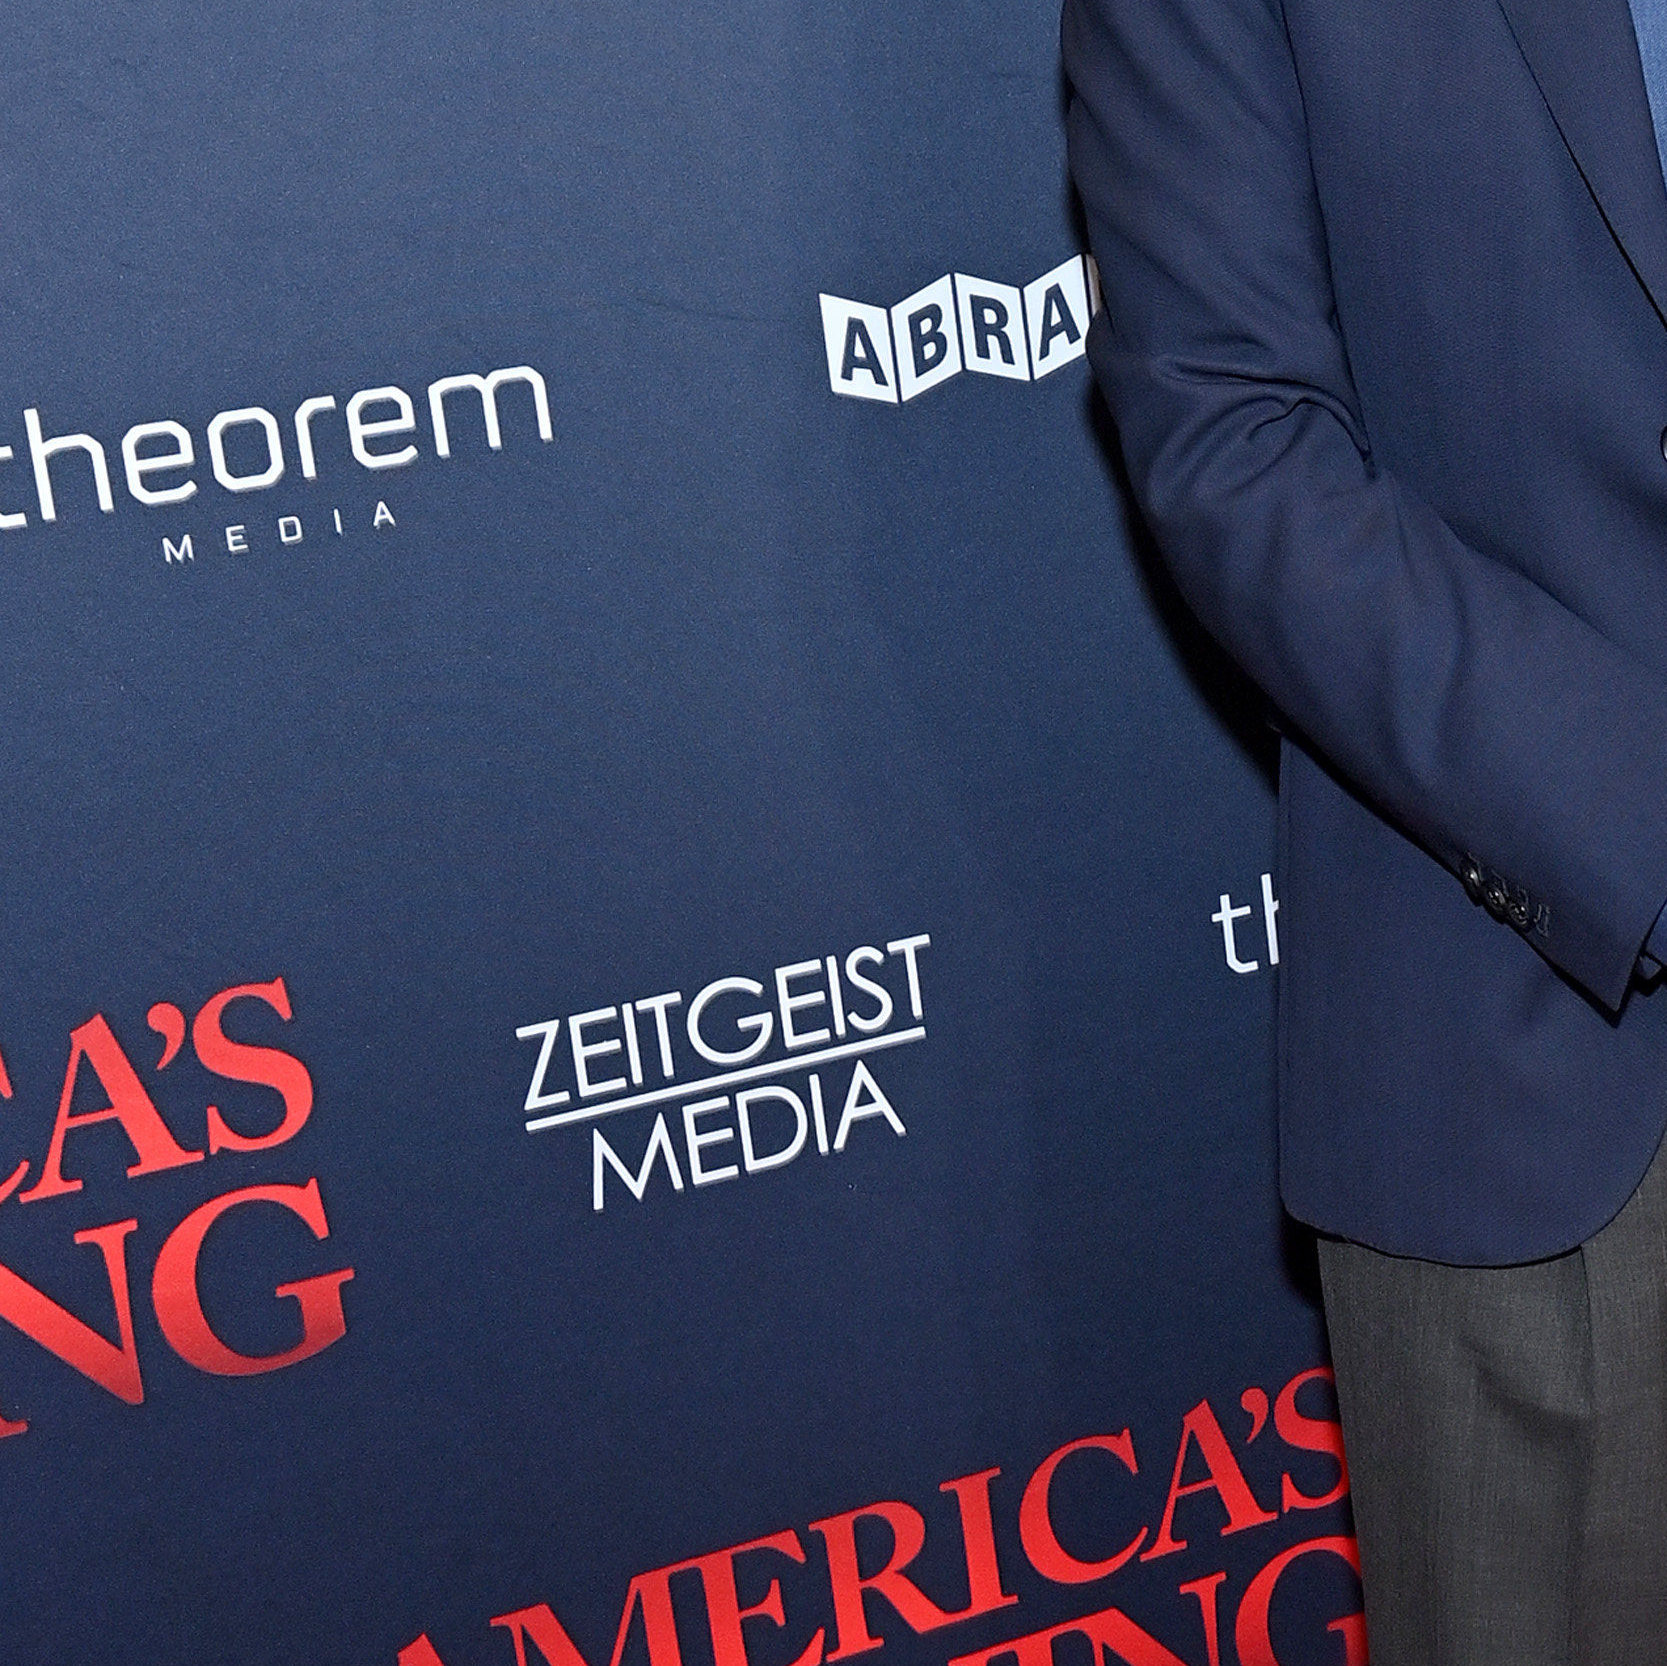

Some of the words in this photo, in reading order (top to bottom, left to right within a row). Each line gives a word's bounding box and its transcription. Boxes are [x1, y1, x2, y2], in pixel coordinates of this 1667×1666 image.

[836, 278, 1086, 391] ABRA
[162, 500, 397, 565] MEDIA
[0, 976, 315, 1205] A'S
[516, 933, 931, 1112] ZEITGEIST
[593, 1059, 908, 1213] MEDIA
